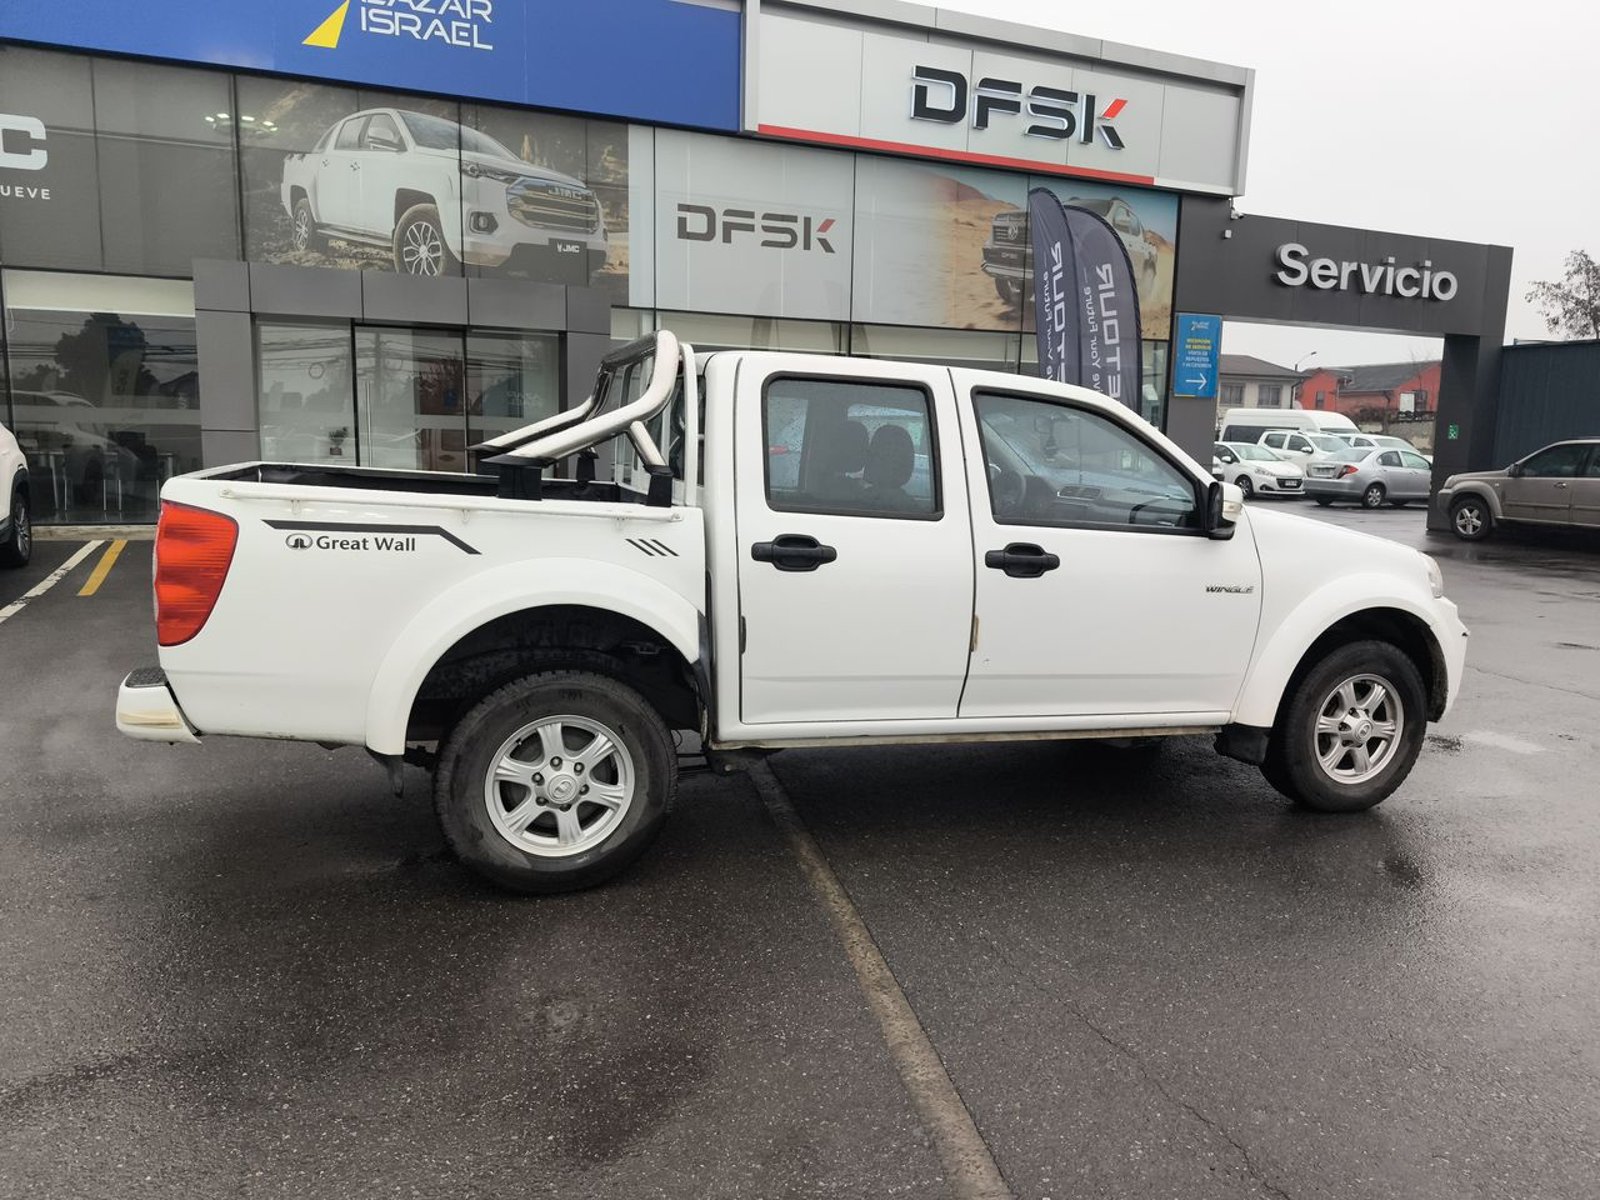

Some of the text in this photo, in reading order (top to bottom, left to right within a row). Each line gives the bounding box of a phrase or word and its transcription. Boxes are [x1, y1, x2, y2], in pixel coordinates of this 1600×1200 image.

[361, 7, 493, 50] ISRAEL
[911, 65, 1128, 150] DFSK
[677, 203, 836, 254] DFSK
[1277, 243, 1458, 301] Servicio
[316, 535, 415, 551] Great Wall
